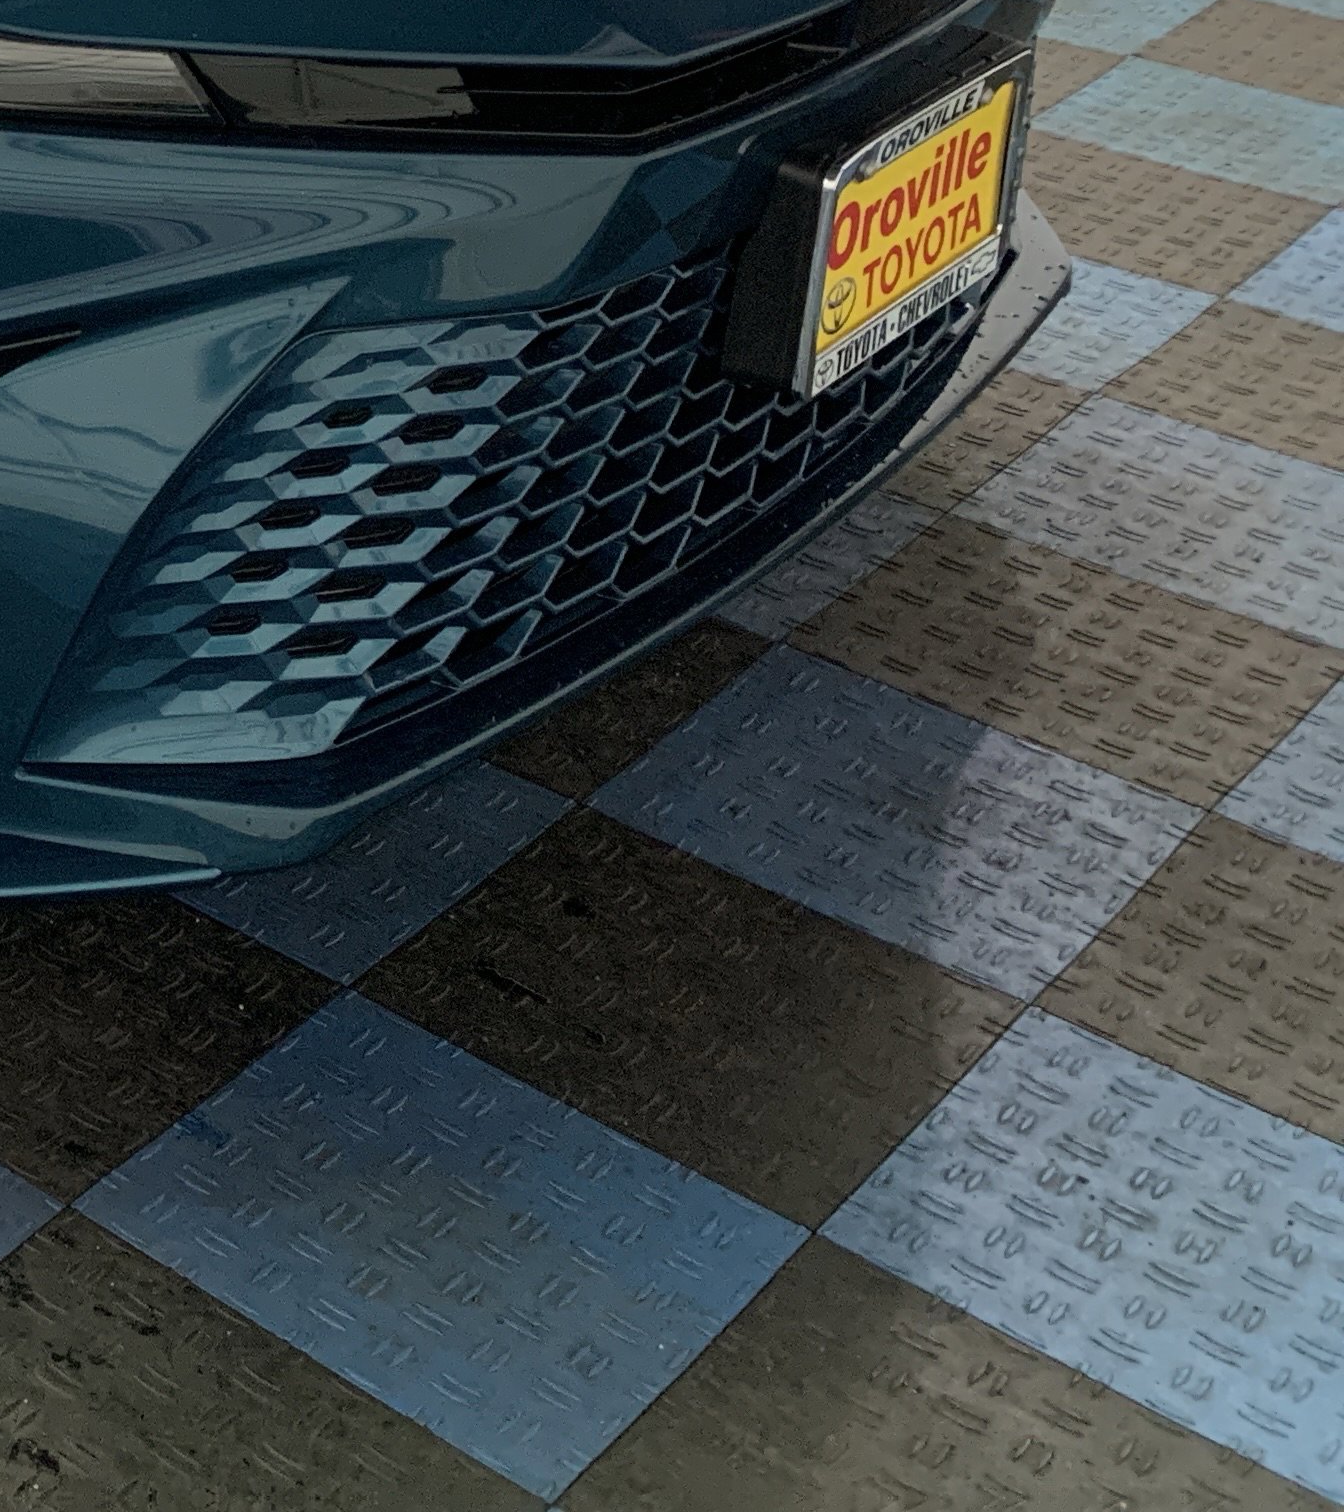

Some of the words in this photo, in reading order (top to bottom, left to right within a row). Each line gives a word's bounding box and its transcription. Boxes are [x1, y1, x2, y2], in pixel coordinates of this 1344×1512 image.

[880, 88, 979, 164] OROVILLE
[827, 128, 991, 271] Oroville
[863, 192, 981, 308] TOYOTA
[836, 319, 888, 376] TOYOTA
